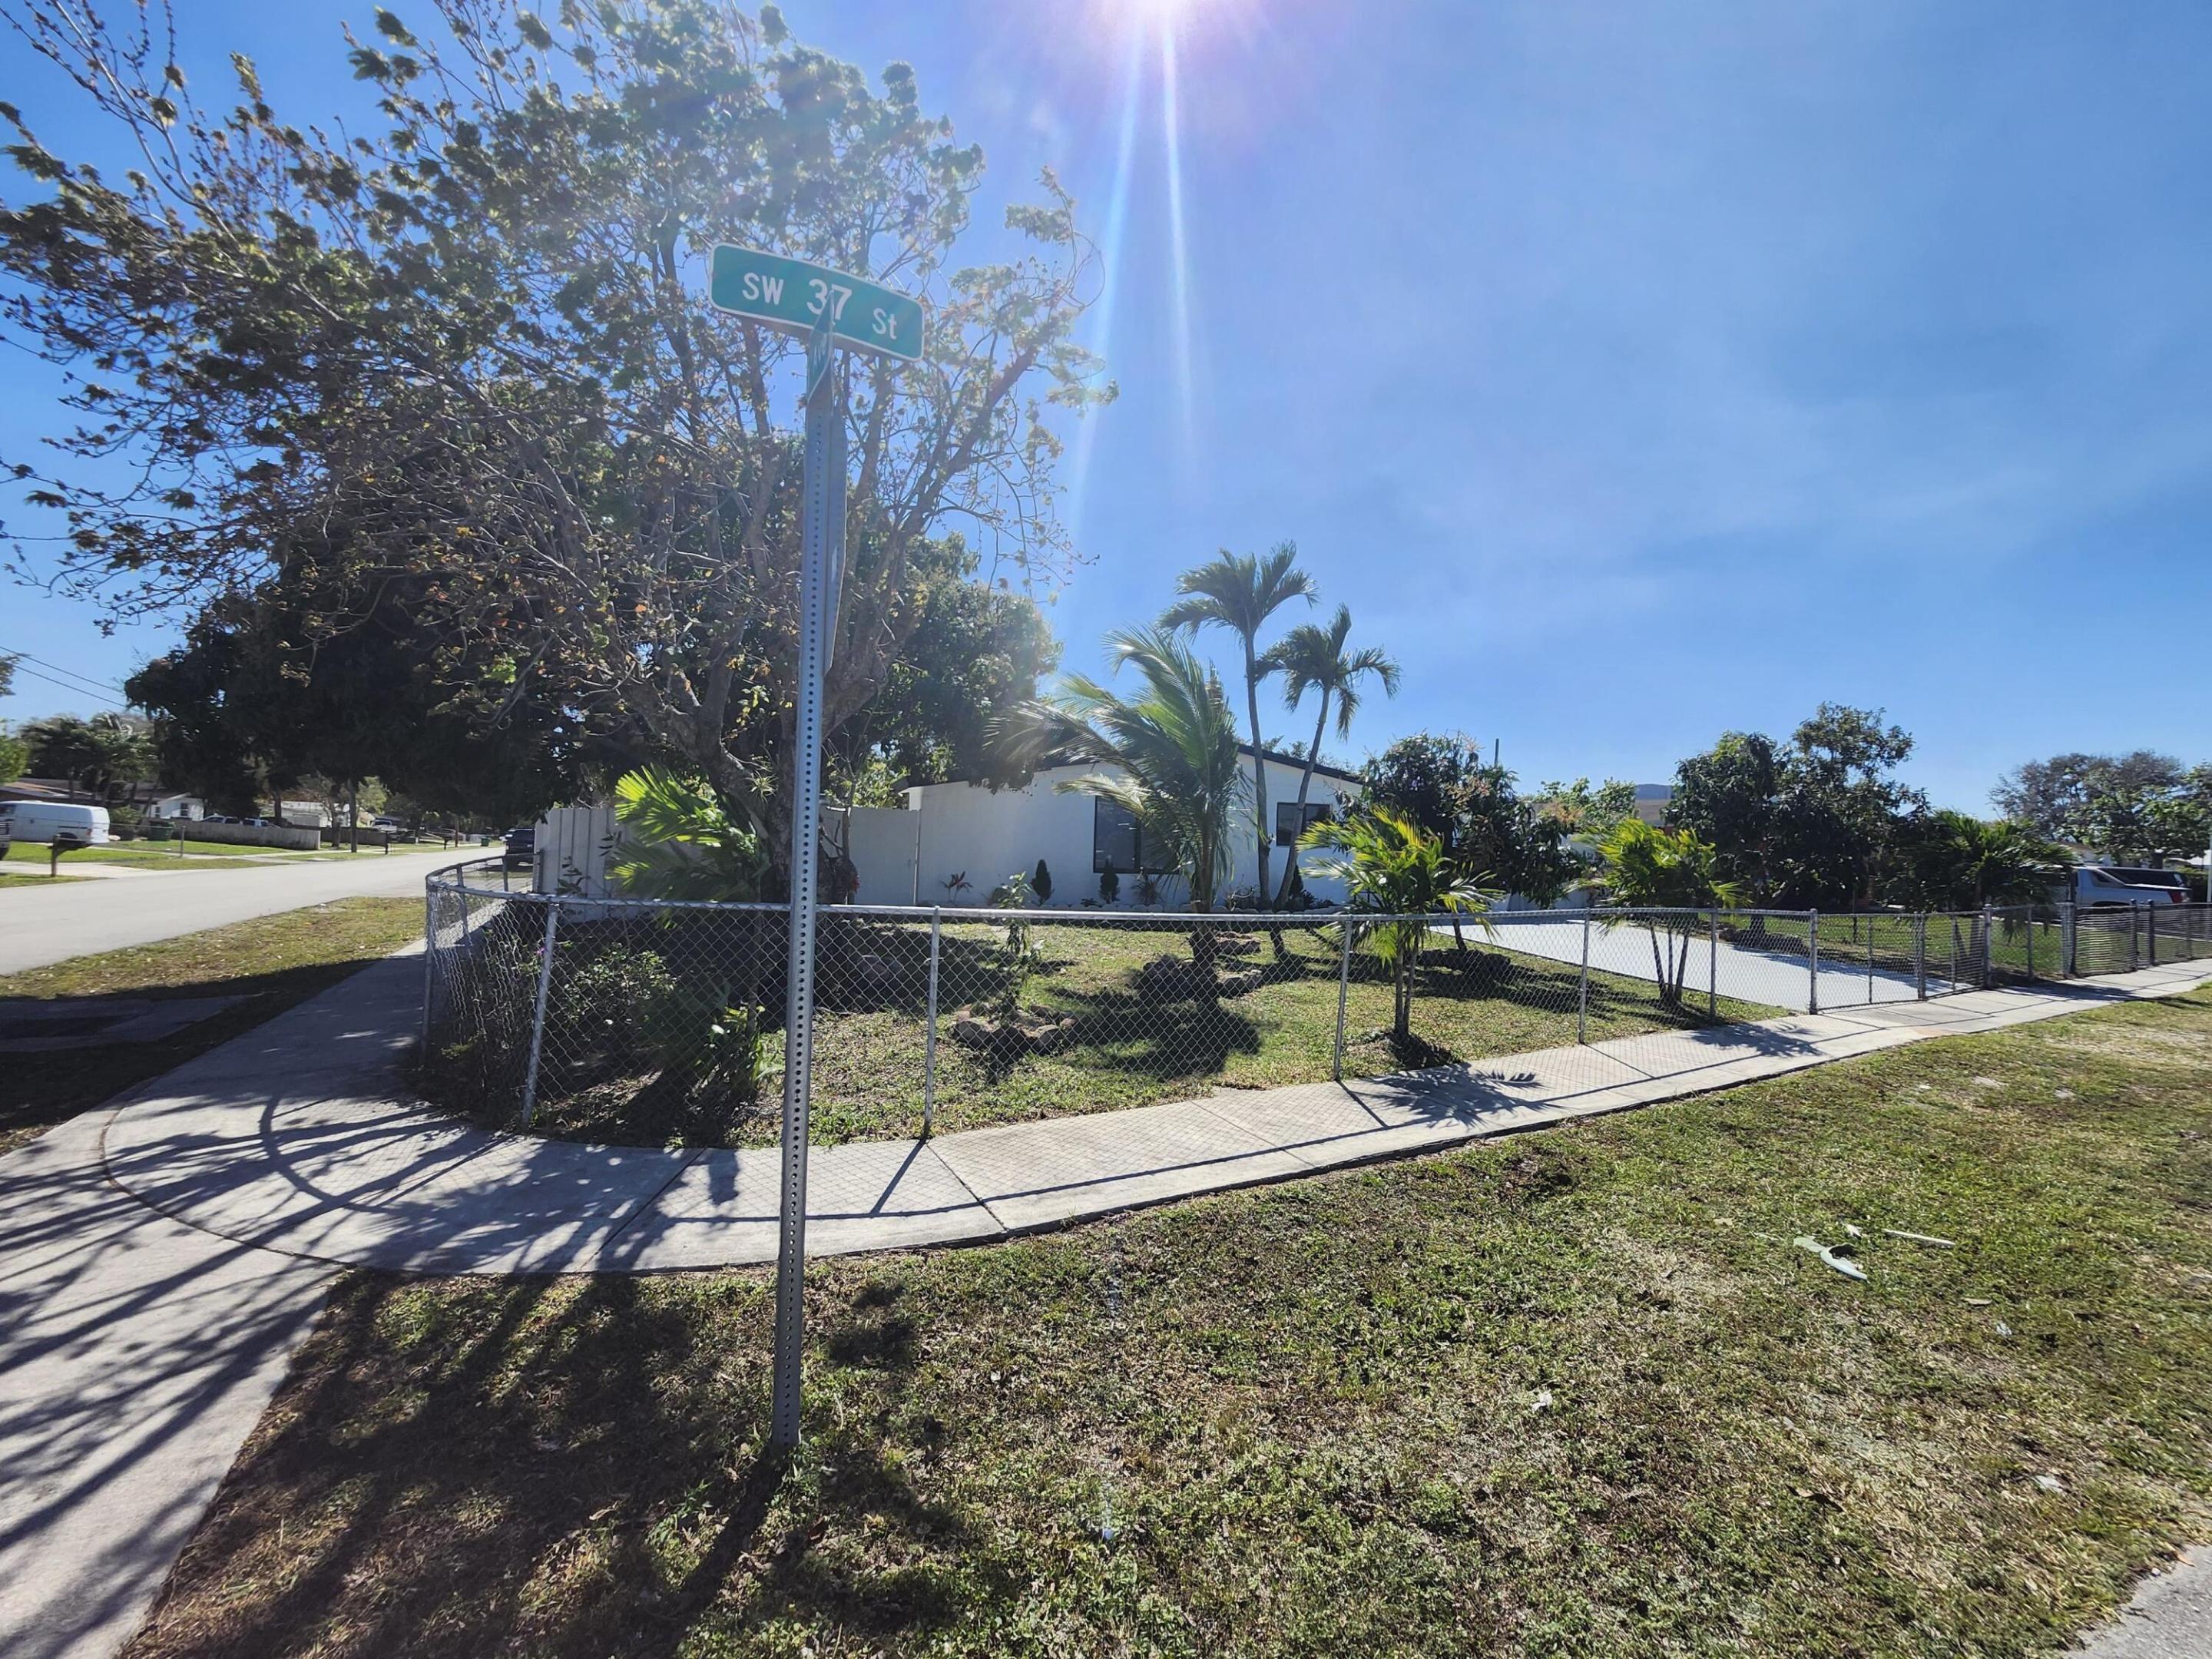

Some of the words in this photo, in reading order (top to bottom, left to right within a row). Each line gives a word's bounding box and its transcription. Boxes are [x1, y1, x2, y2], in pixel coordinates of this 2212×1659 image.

[742, 272, 784, 305] SW
[806, 278, 853, 320] 37
[872, 307, 898, 339] St
